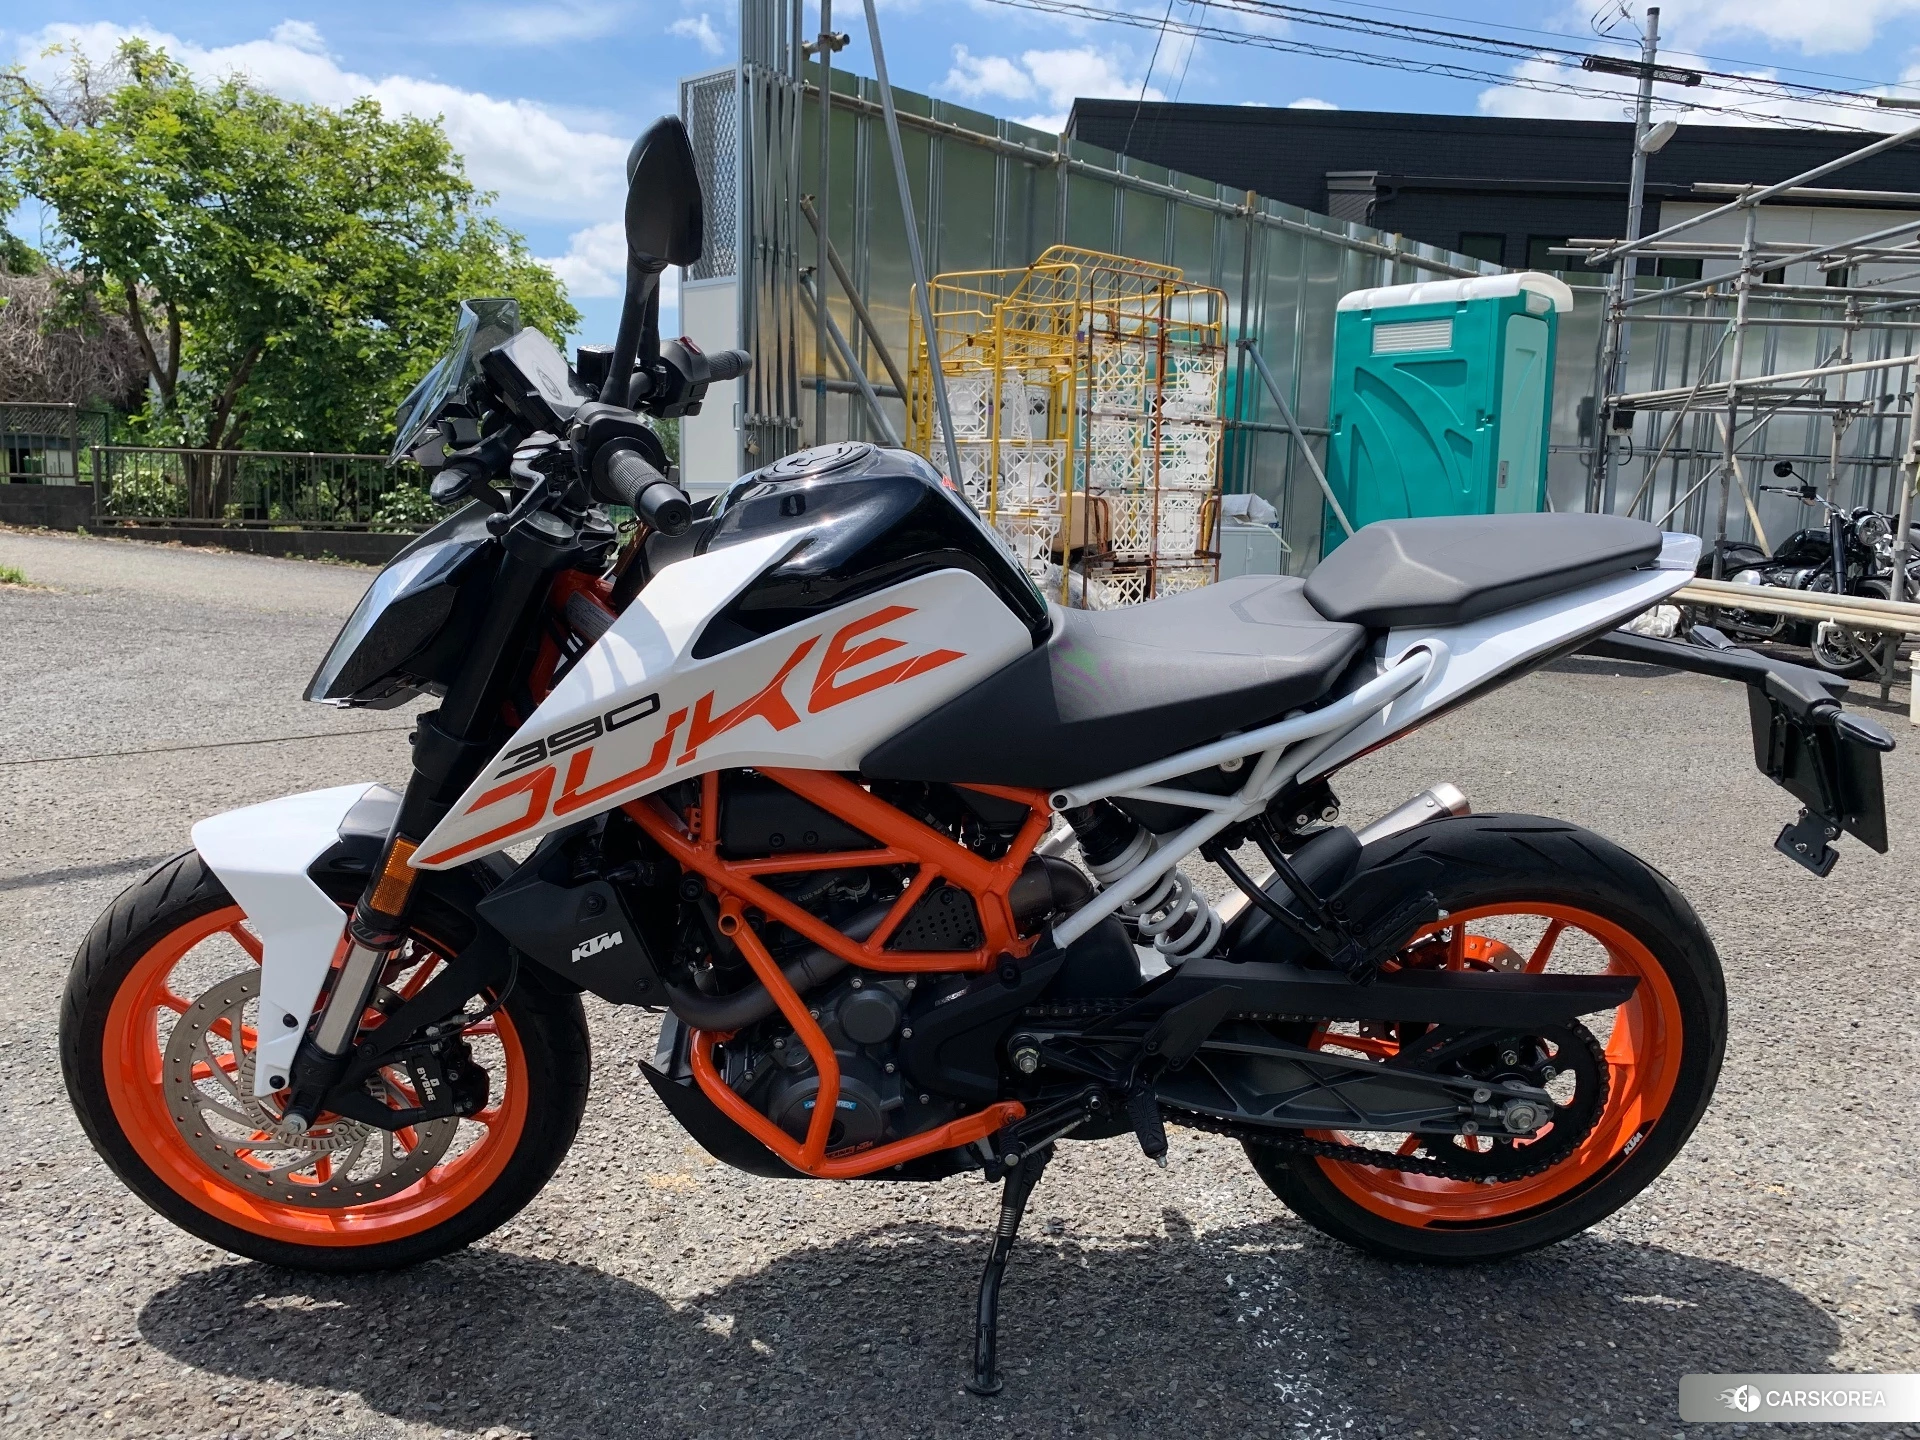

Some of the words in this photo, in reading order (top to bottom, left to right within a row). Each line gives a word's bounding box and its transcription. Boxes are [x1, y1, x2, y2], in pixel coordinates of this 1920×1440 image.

[419, 605, 967, 864] DUKE
[494, 693, 659, 780] 390
[571, 930, 623, 963] KTM
[417, 1067, 436, 1101] BYBRE
[1623, 1131, 1644, 1156] KTM
